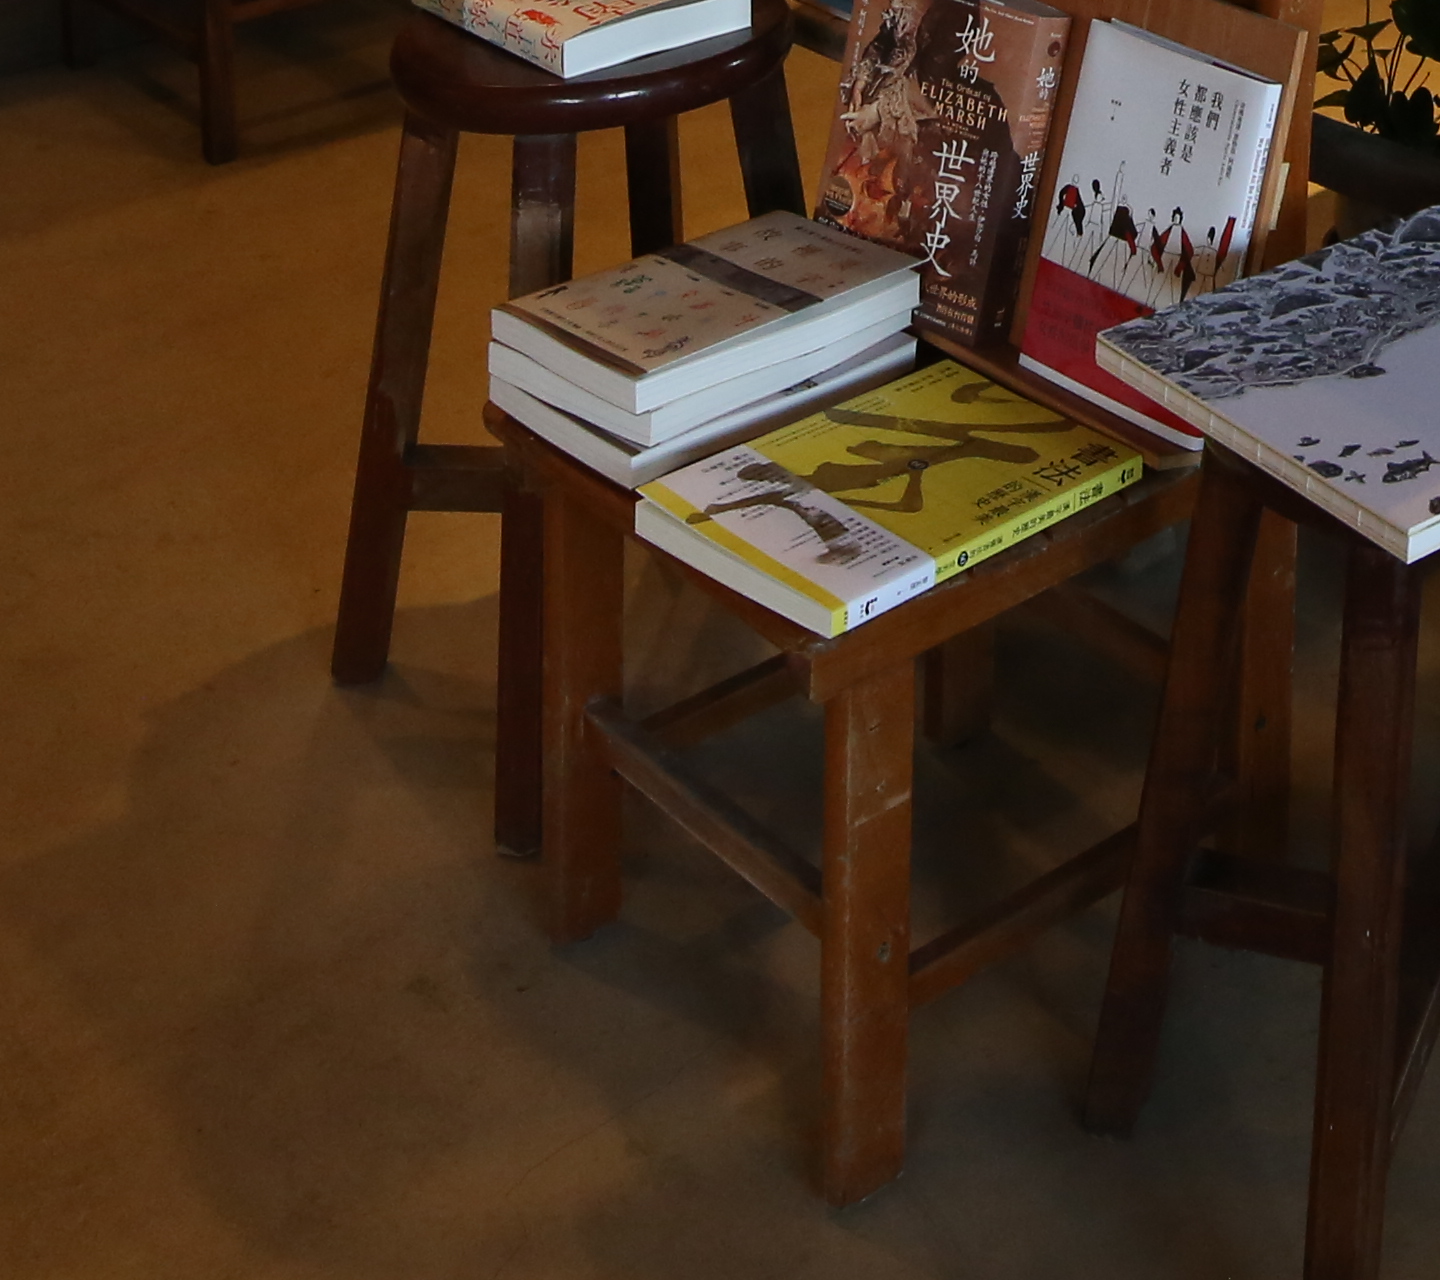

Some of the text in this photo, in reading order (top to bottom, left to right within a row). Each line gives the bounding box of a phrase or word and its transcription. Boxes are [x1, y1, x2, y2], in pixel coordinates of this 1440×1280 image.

[919, 81, 1009, 122] ELIZABETH
[934, 100, 987, 131] MARSH
[1180, 84, 1208, 164] 都應該是
[1205, 90, 1224, 131] 我們
[1159, 78, 1191, 177] 女性主義者
[916, 139, 976, 278] 世界史
[1011, 150, 1040, 220] 世界史
[1032, 441, 1120, 488] 書法
[1077, 480, 1106, 512] 書法
